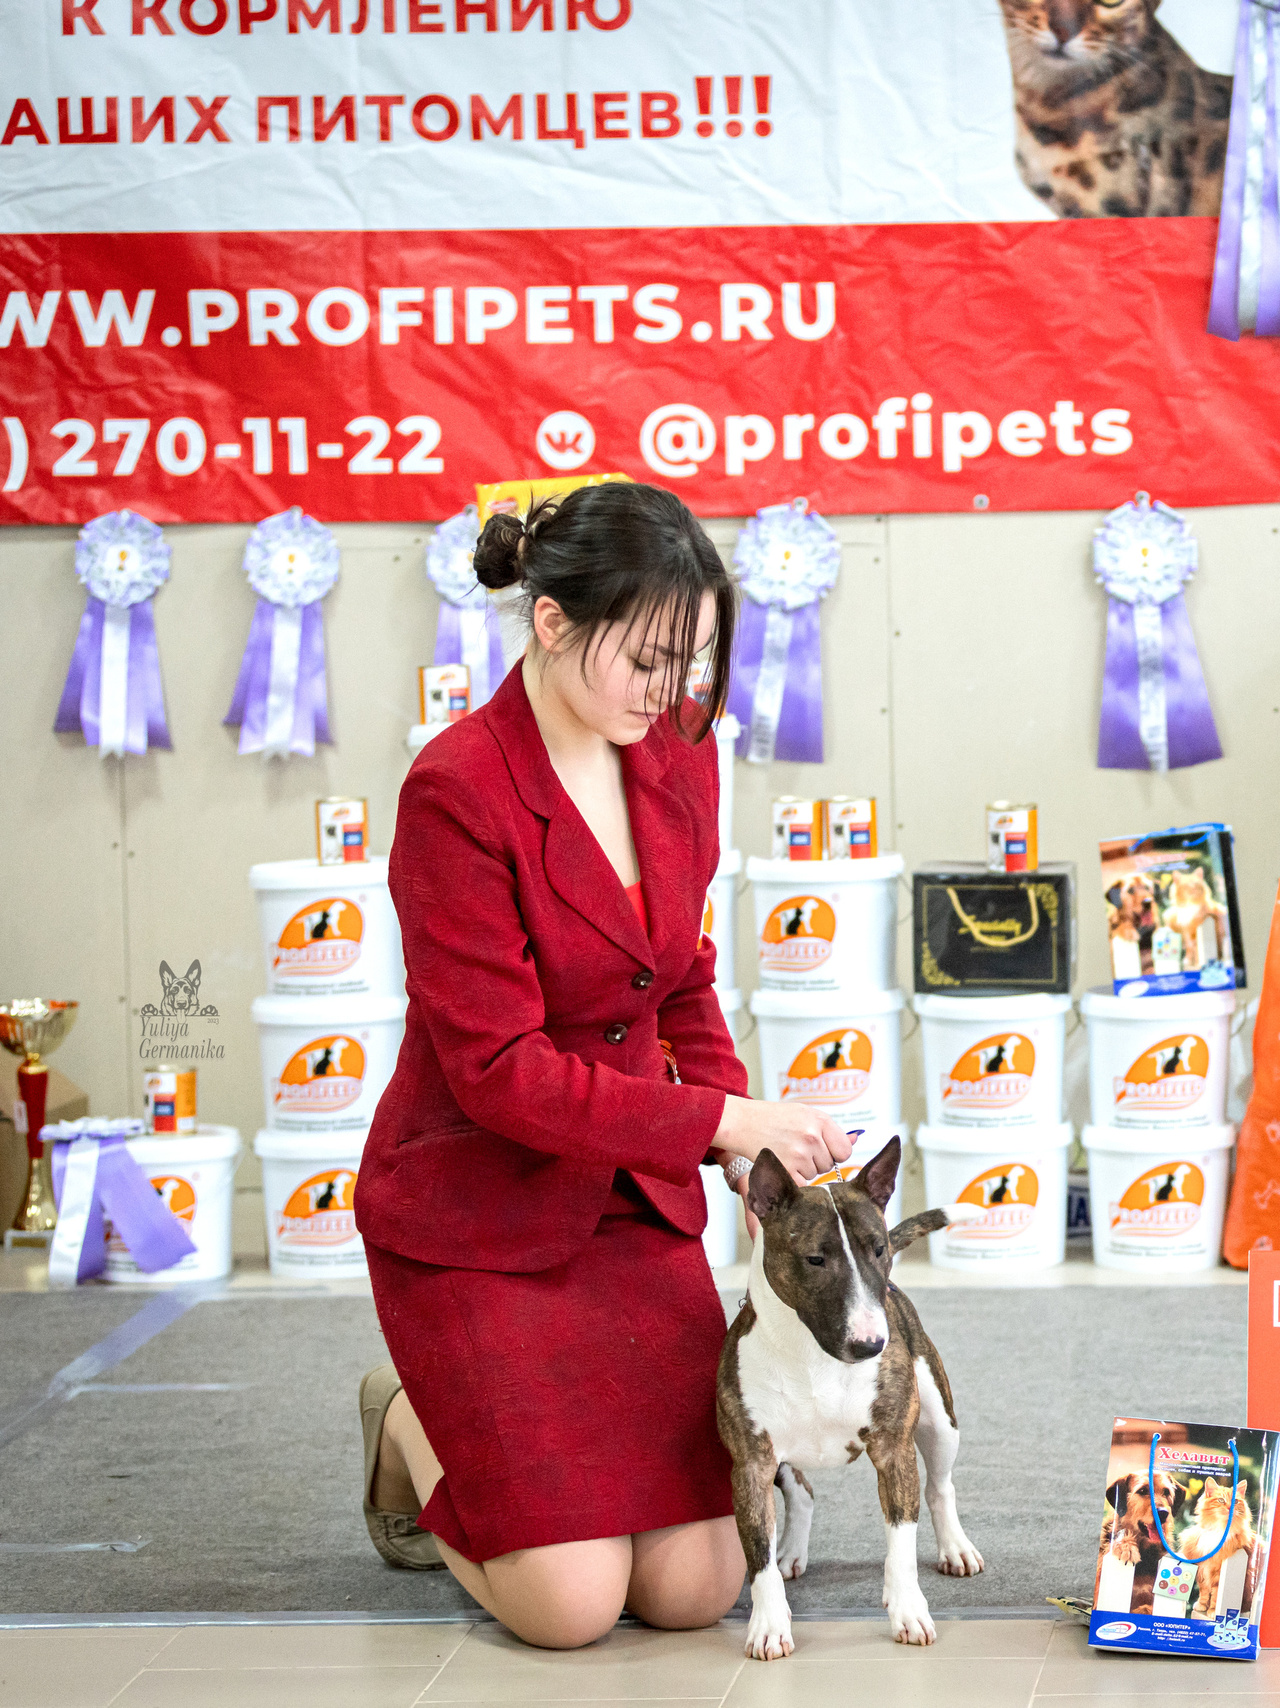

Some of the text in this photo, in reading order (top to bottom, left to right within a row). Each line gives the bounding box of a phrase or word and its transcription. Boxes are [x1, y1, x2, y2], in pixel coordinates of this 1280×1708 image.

[62, 0, 632, 36] К КОРМЛЕНИЮ
[1, 75, 775, 150] АШИХ ПИТОМЦЕВ!!!
[50, 414, 445, 477] 270-11-22
[639, 391, 1134, 477] @profipets
[1158, 1447, 1231, 1465] Хелавит
[1153, 1621, 1165, 1629] ООО
